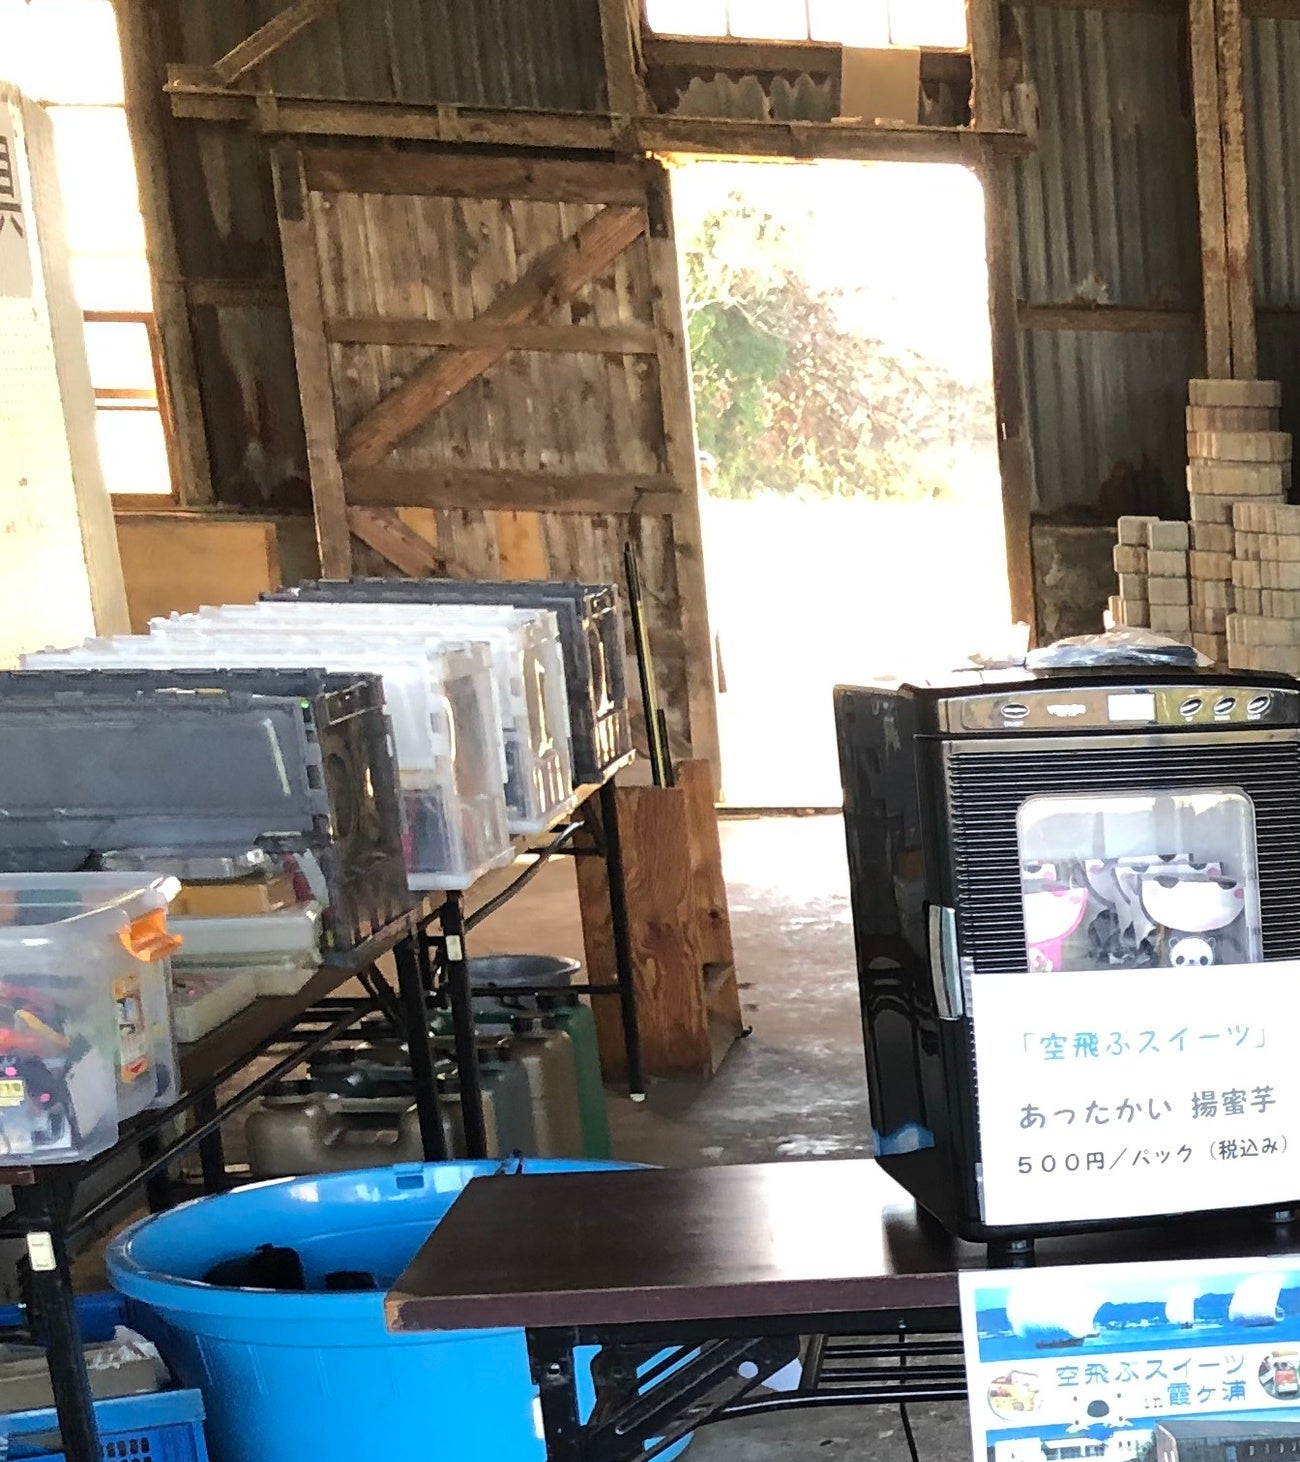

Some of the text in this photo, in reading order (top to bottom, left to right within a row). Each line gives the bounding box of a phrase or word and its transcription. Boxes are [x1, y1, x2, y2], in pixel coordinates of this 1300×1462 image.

[1055, 1353, 1245, 1387] 空飛ぶスイーツ
